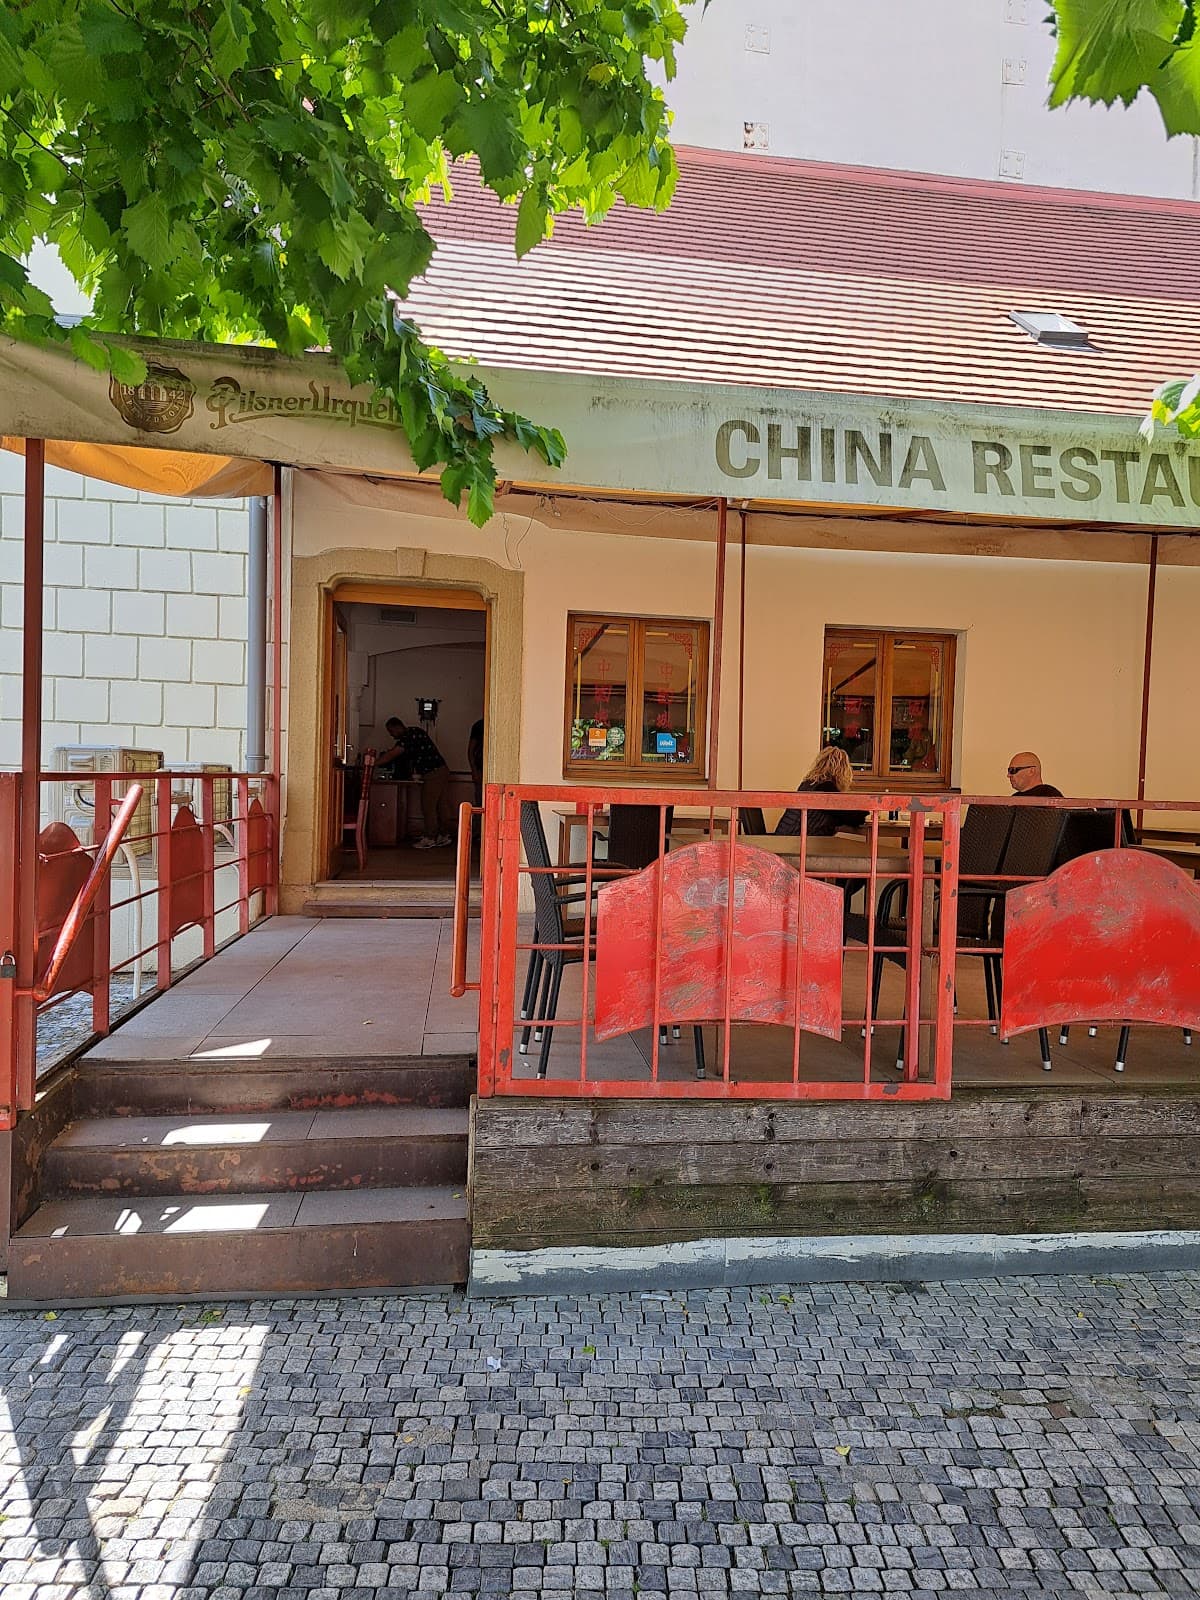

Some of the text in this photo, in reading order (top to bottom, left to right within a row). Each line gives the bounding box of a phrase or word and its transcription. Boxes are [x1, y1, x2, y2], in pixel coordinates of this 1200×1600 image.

[169, 390, 184, 400] 42
[206, 376, 311, 429] Pilsner
[715, 419, 947, 492] CHINA
